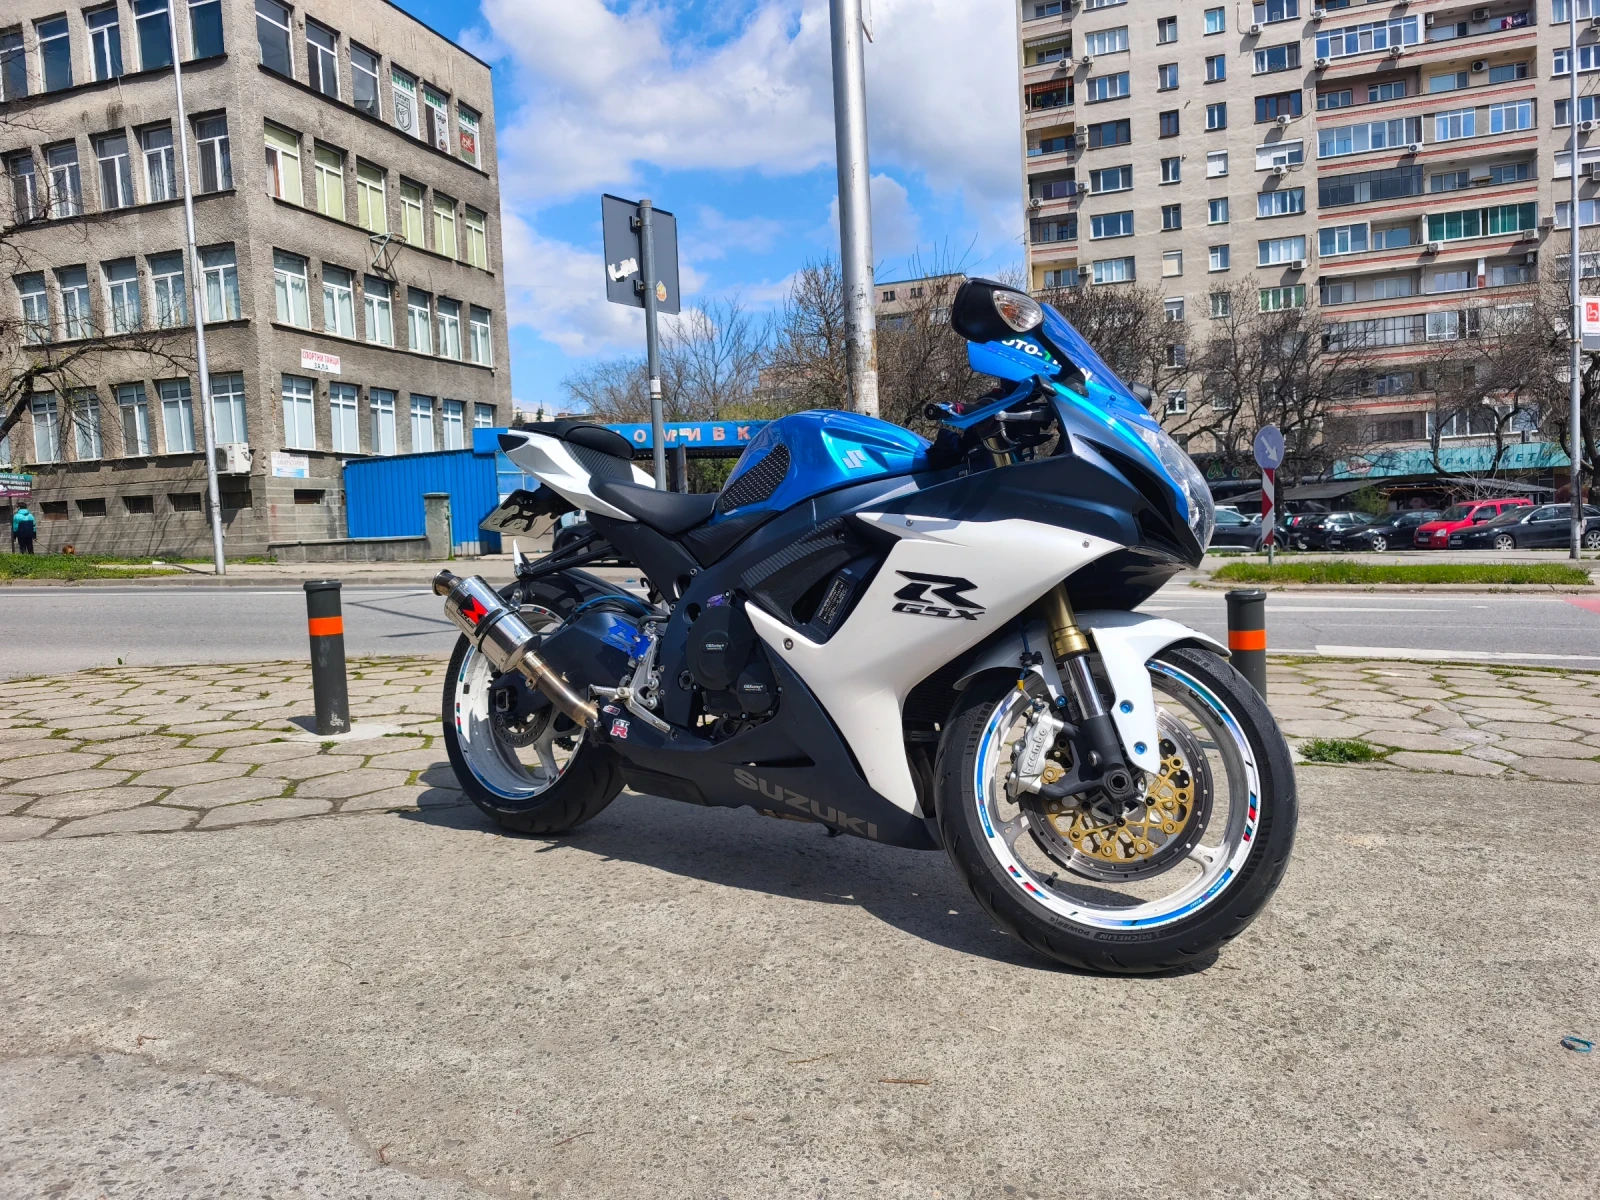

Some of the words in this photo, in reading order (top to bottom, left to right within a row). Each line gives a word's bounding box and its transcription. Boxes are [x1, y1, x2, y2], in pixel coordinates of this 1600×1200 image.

[314, 362, 329, 370] ЗАЛА
[892, 603, 985, 620] GSX
[1022, 729, 1047, 774] brembo
[733, 768, 878, 839] SUZUKI
[1056, 920, 1090, 936] POWER
[1100, 932, 1152, 942] MICHELIN
